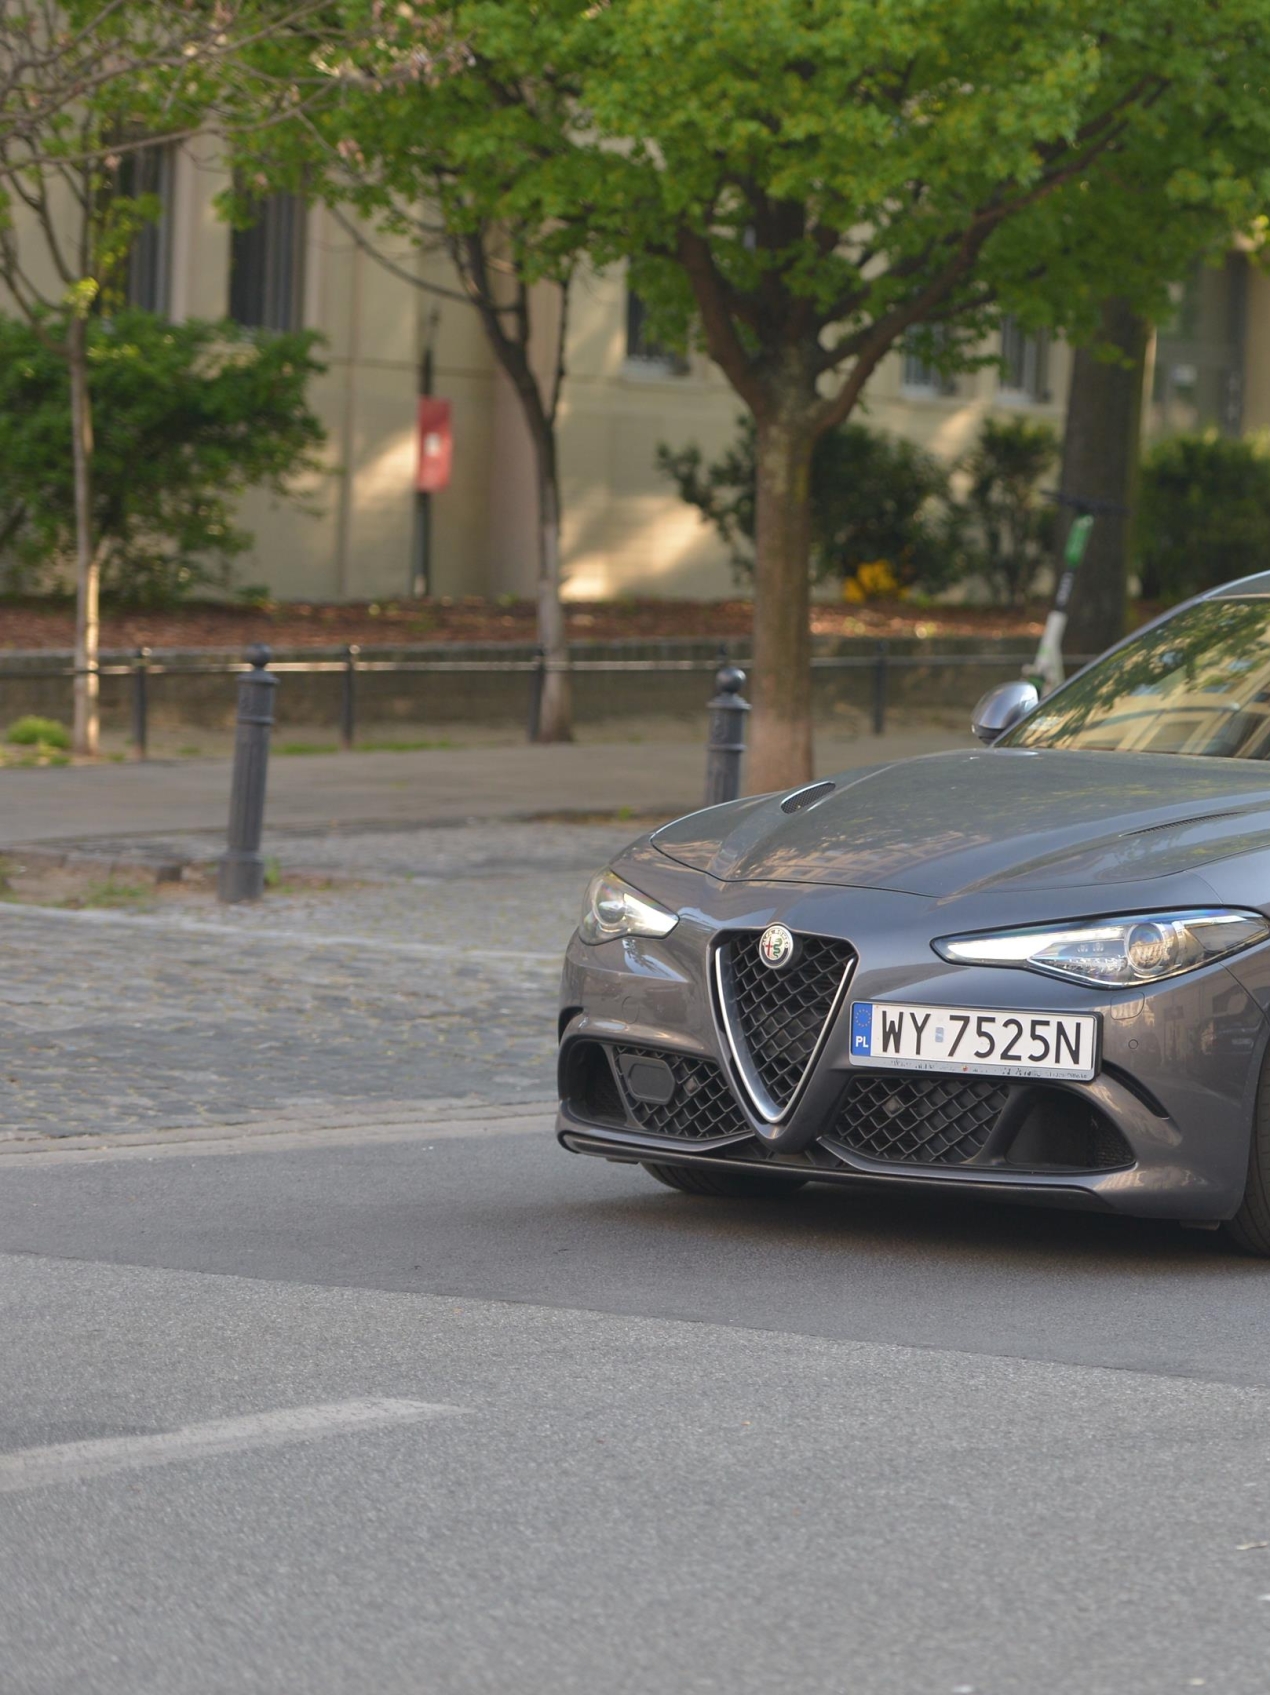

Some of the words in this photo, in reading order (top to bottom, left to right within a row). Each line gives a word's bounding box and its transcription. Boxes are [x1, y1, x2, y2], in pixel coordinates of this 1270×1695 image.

[855, 1035, 869, 1048] PL
[882, 1010, 931, 1055] WY
[947, 1014, 1082, 1065] 7525N
